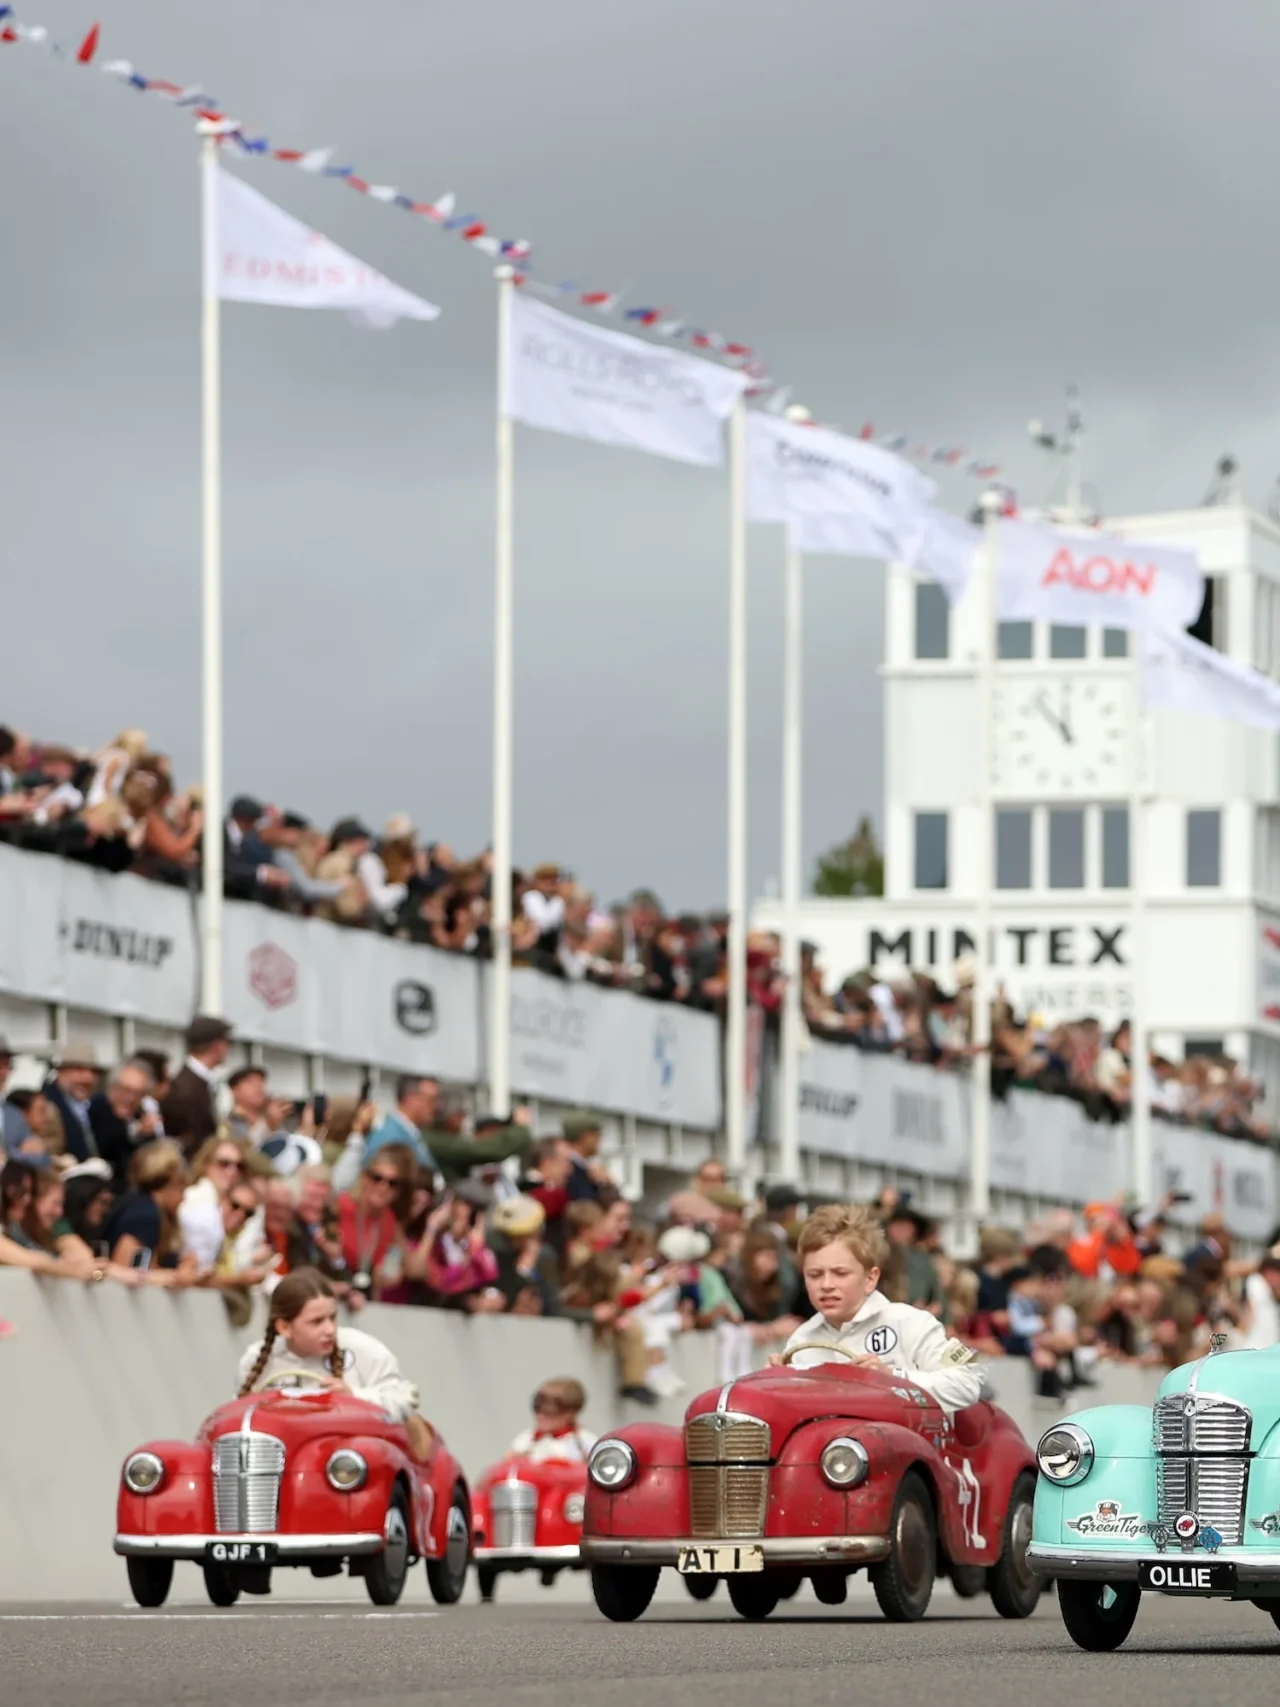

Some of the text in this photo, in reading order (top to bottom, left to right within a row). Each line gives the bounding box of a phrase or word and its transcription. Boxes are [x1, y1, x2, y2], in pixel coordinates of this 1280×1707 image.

[1041, 547, 1157, 597] AON
[74, 917, 174, 970] DUNLOP
[867, 925, 1126, 967] MINTEX
[212, 1543, 251, 1561] GJF
[682, 1549, 718, 1571] AT
[1150, 1565, 1212, 1588] OLLIE
